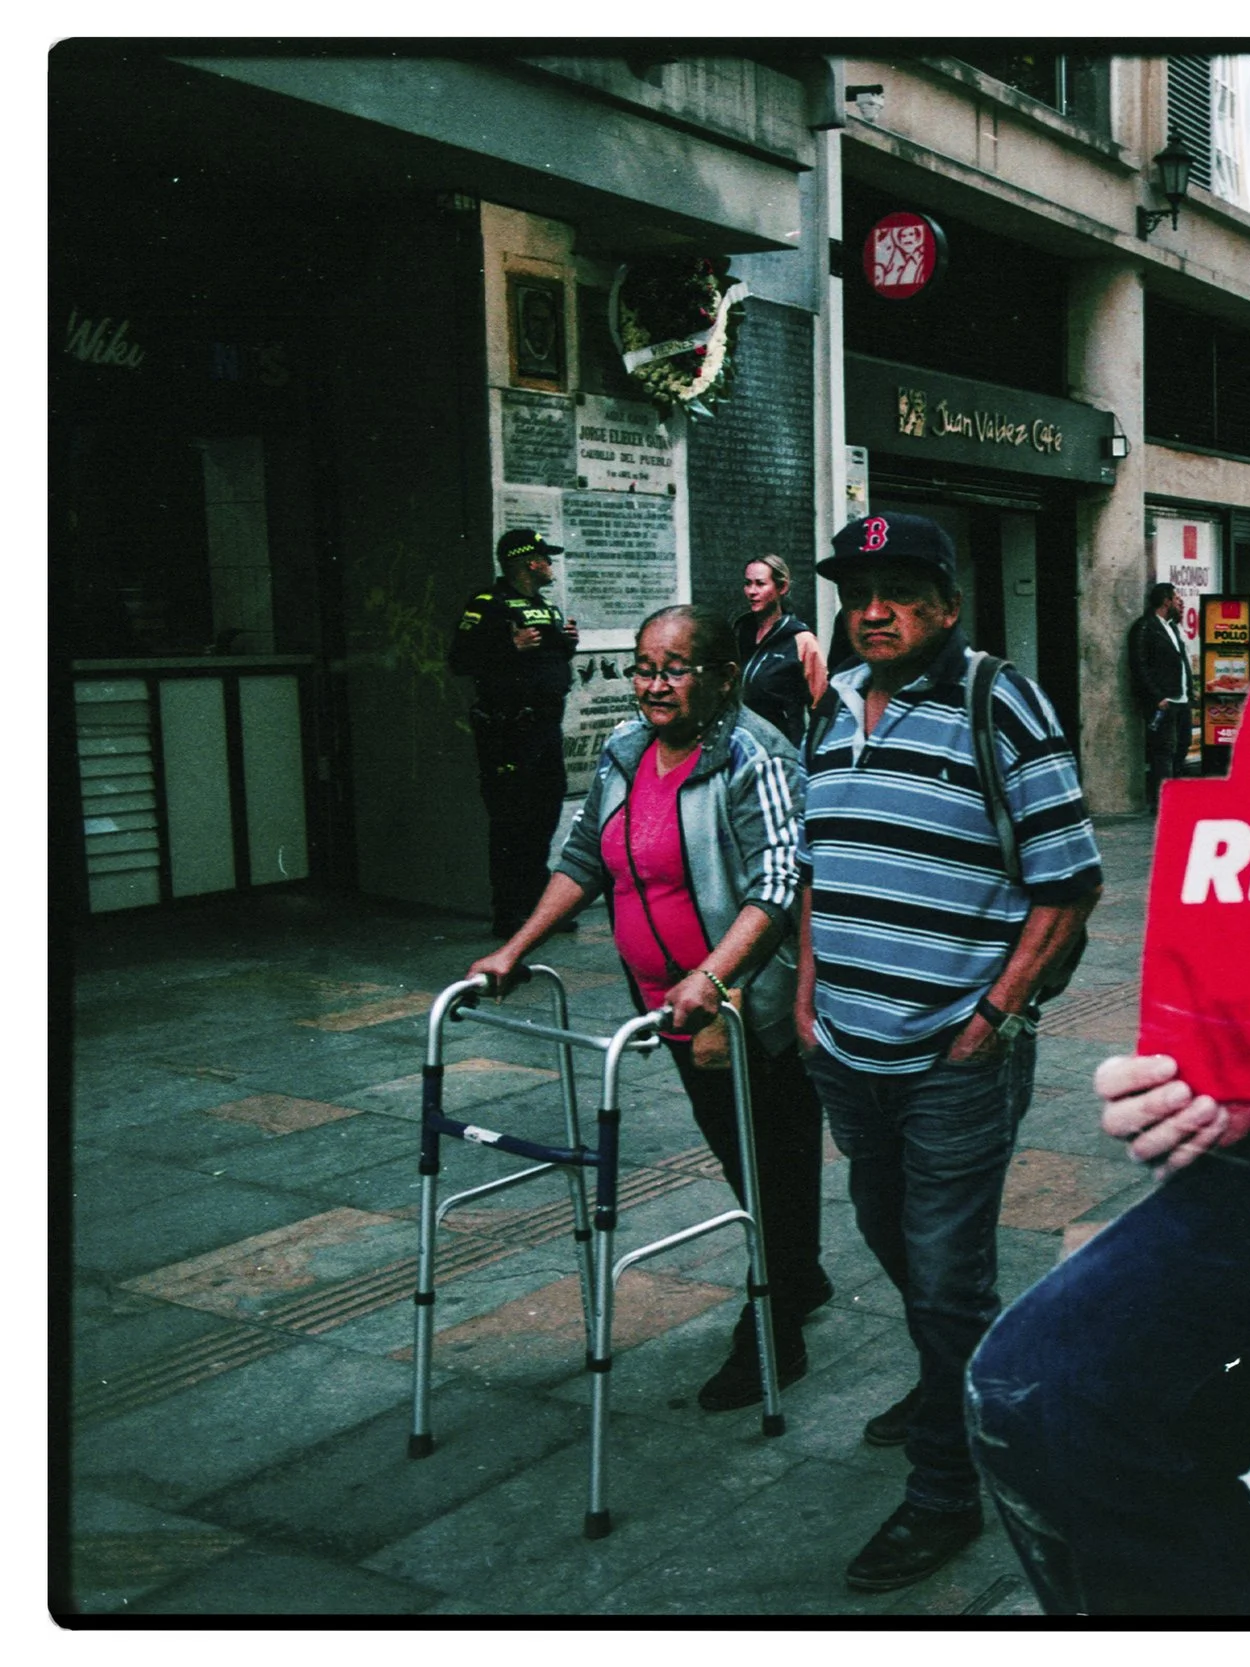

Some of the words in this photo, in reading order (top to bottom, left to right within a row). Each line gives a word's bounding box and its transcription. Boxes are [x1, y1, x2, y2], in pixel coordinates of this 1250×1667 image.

[579, 426, 607, 443] JORGE
[932, 400, 974, 437] Juan
[974, 411, 1028, 446] Valdez
[1032, 419, 1063, 453] Café
[619, 453, 636, 465] DEL
[639, 455, 673, 468] PUEBLO
[858, 517, 890, 553] B
[1214, 630, 1248, 641] POLLO
